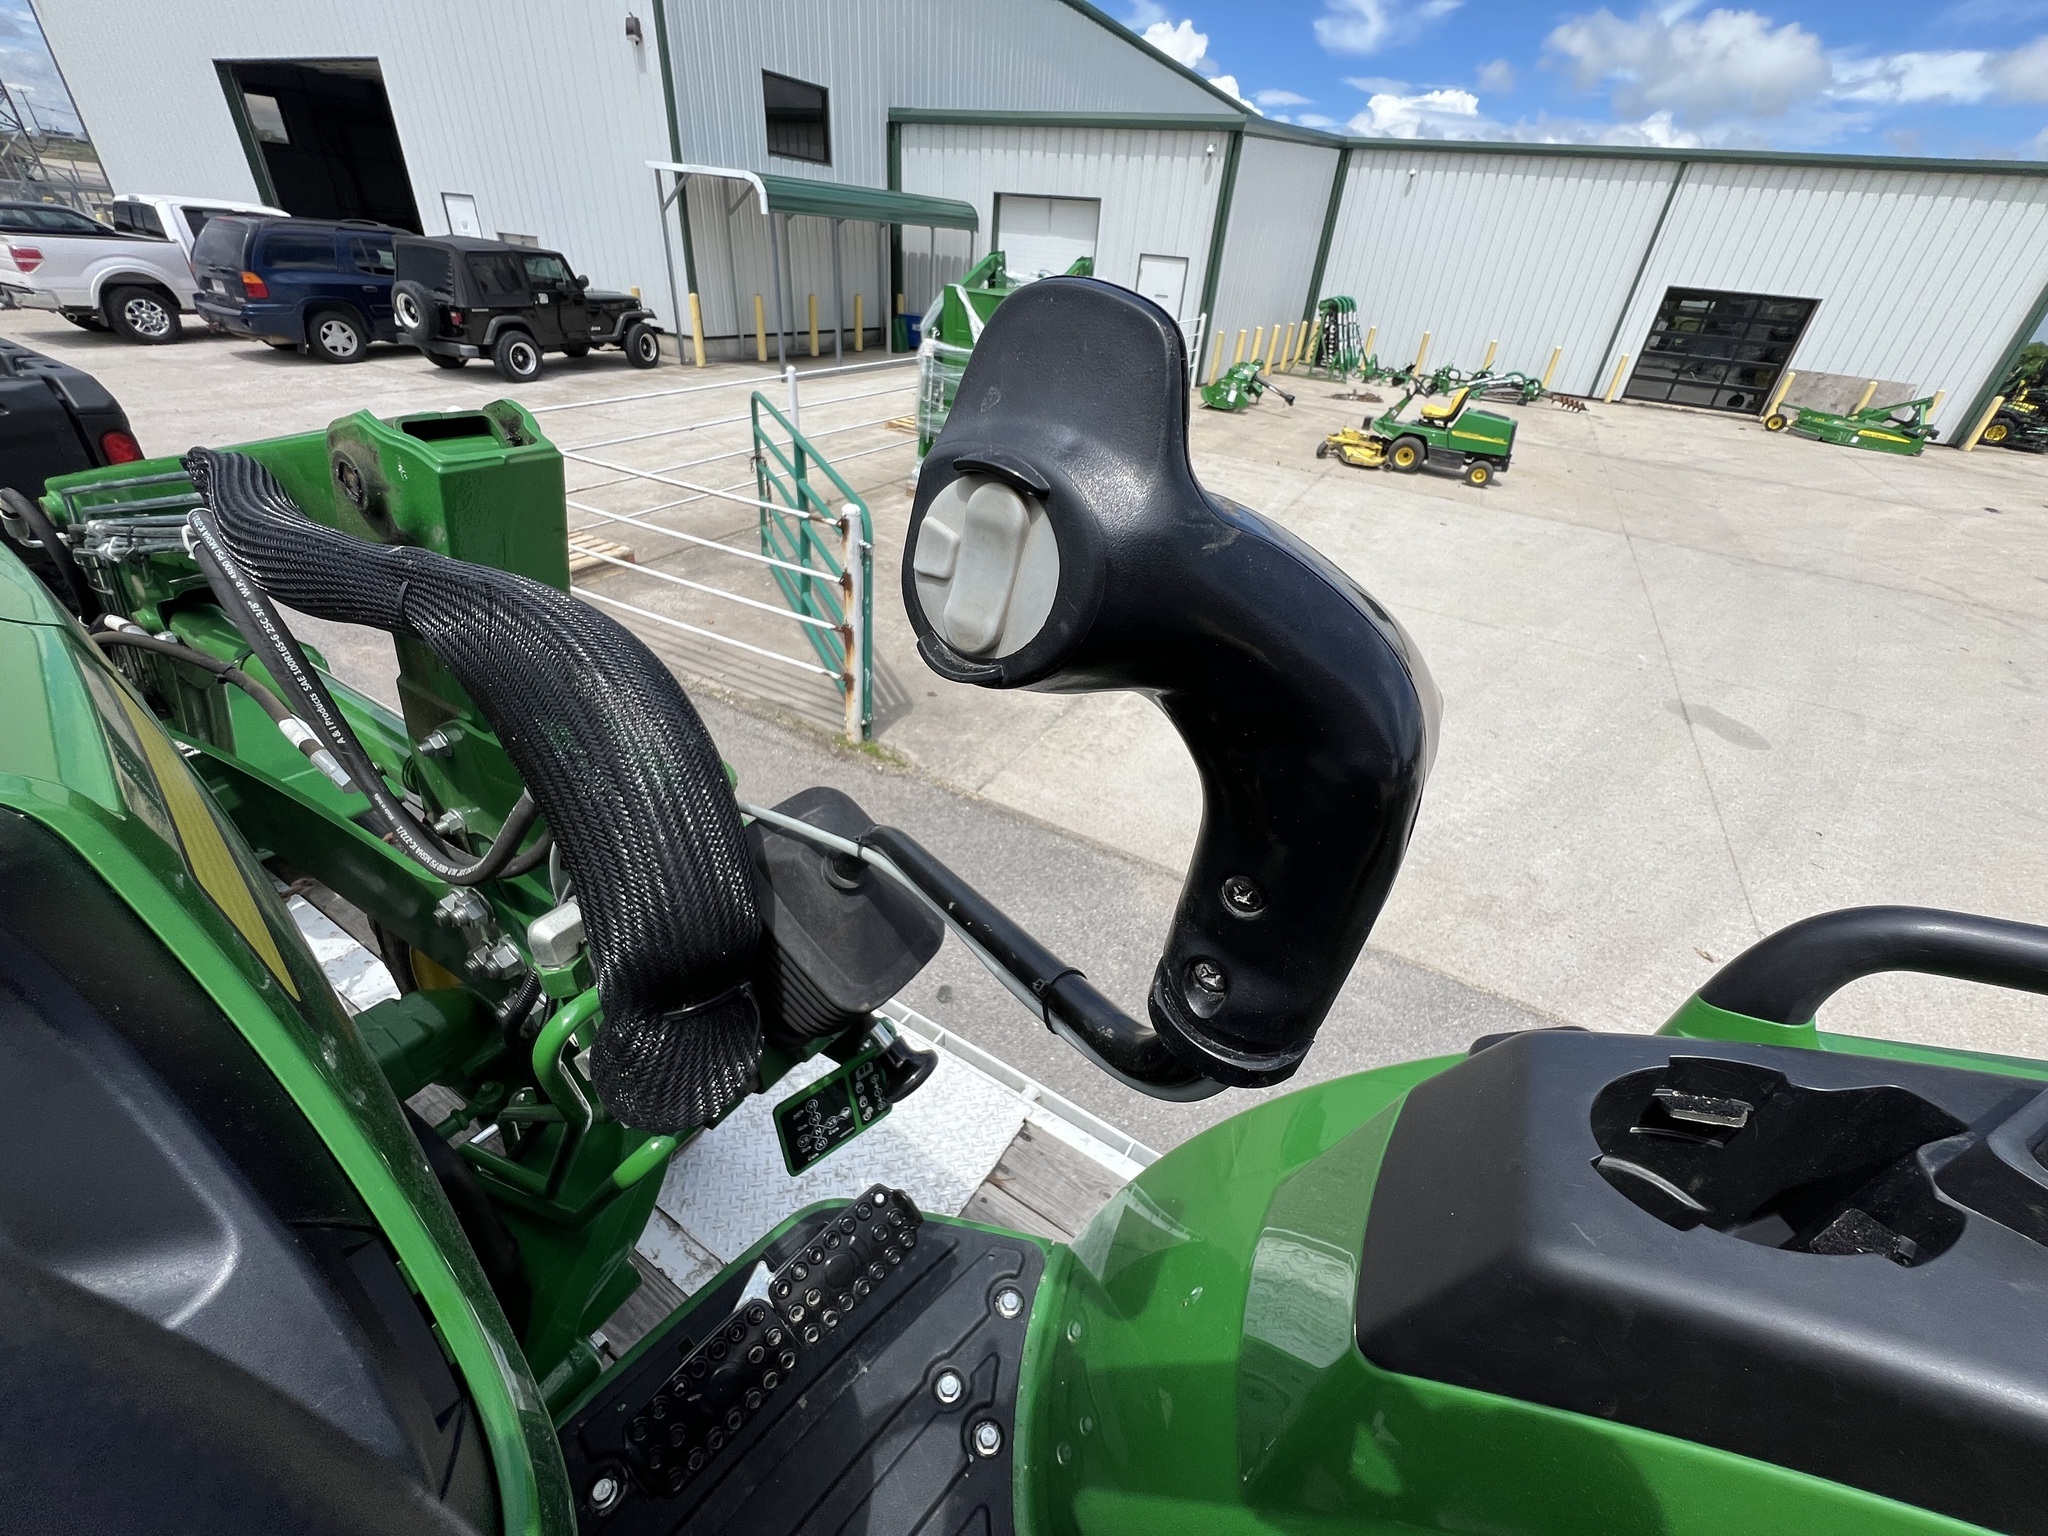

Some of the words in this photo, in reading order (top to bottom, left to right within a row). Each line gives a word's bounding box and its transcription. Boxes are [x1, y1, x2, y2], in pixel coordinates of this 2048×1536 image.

[201, 530, 219, 550] MSHA
[214, 548, 227, 561] PSI
[221, 560, 237, 580] 4800
[235, 579, 251, 598] W.P.
[259, 617, 276, 634] 2SC
[270, 633, 303, 676] 100R16S-6
[296, 675, 312, 692] SAE
[309, 692, 335, 728] Products
[331, 730, 341, 738] &
[395, 825, 418, 851] IC-272/1
[414, 846, 433, 866] MSHA
